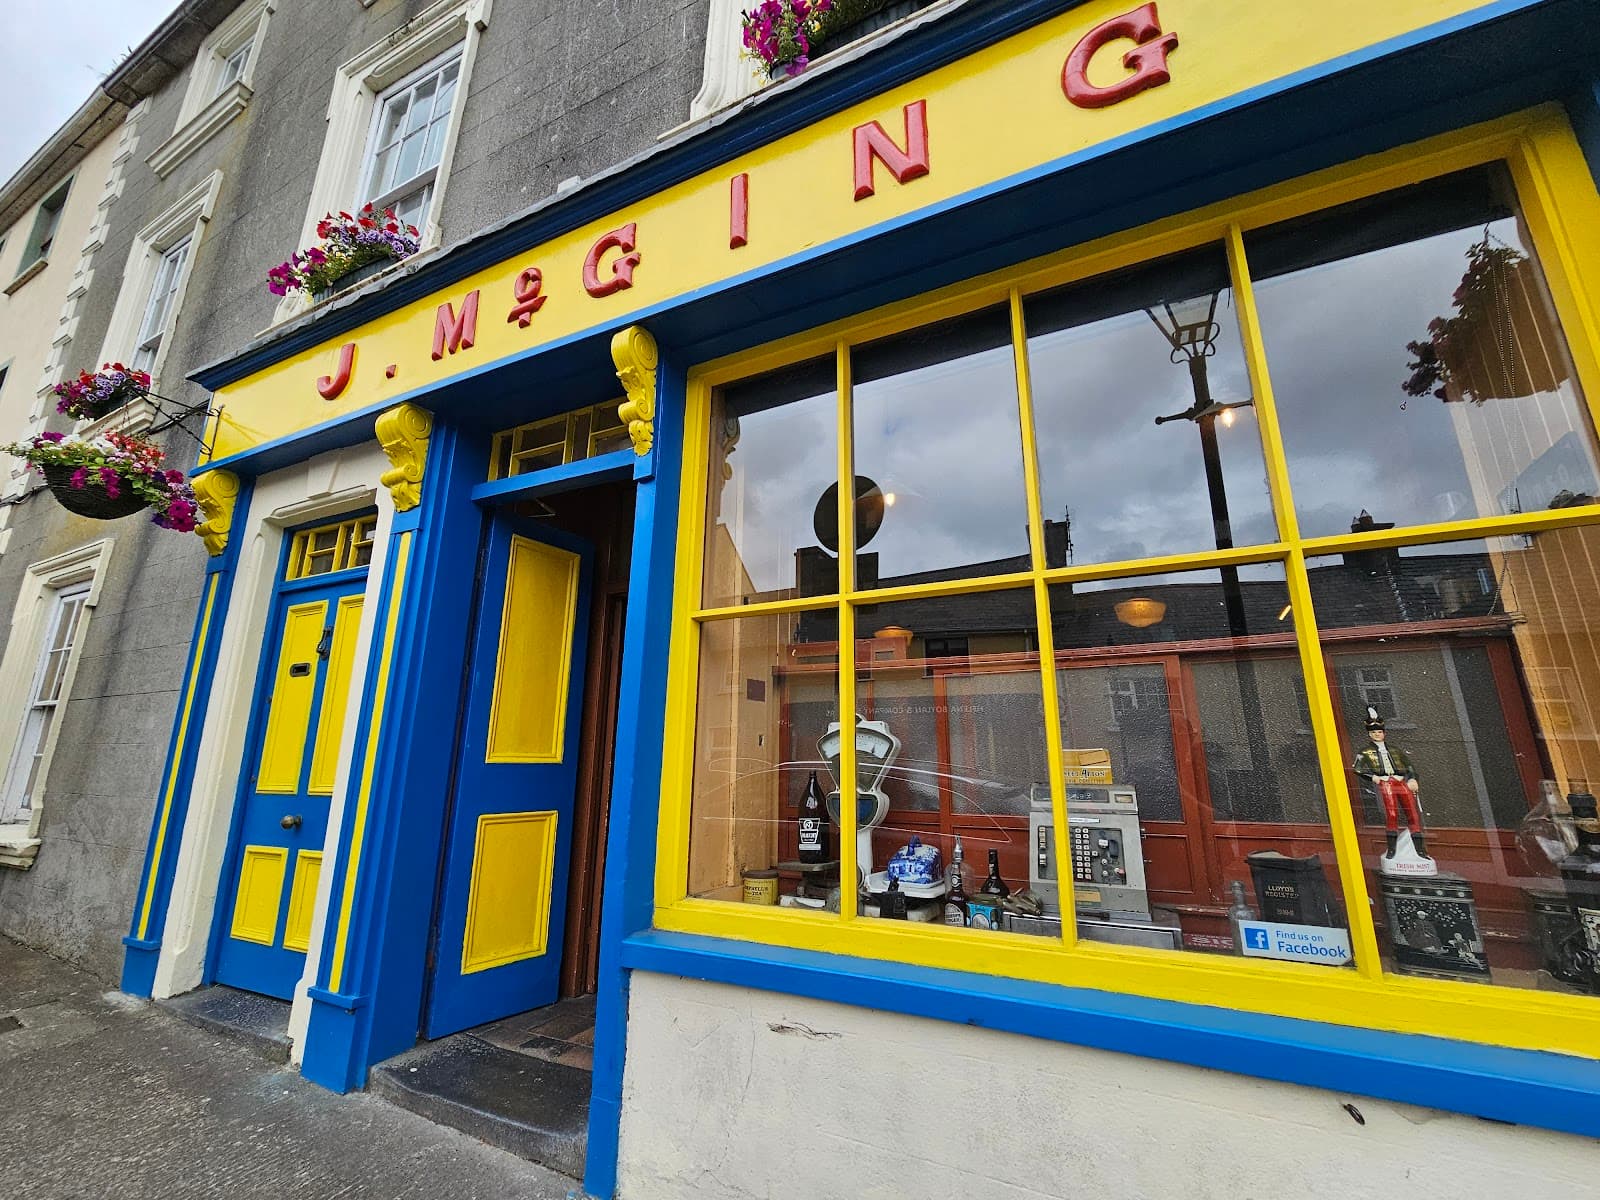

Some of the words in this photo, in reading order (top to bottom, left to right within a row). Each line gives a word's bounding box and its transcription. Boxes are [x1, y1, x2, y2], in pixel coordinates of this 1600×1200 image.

[1275, 930, 1297, 940] Find
[1297, 933, 1309, 942] us
[1311, 934, 1324, 943] on
[1277, 941, 1347, 958] Facebook
